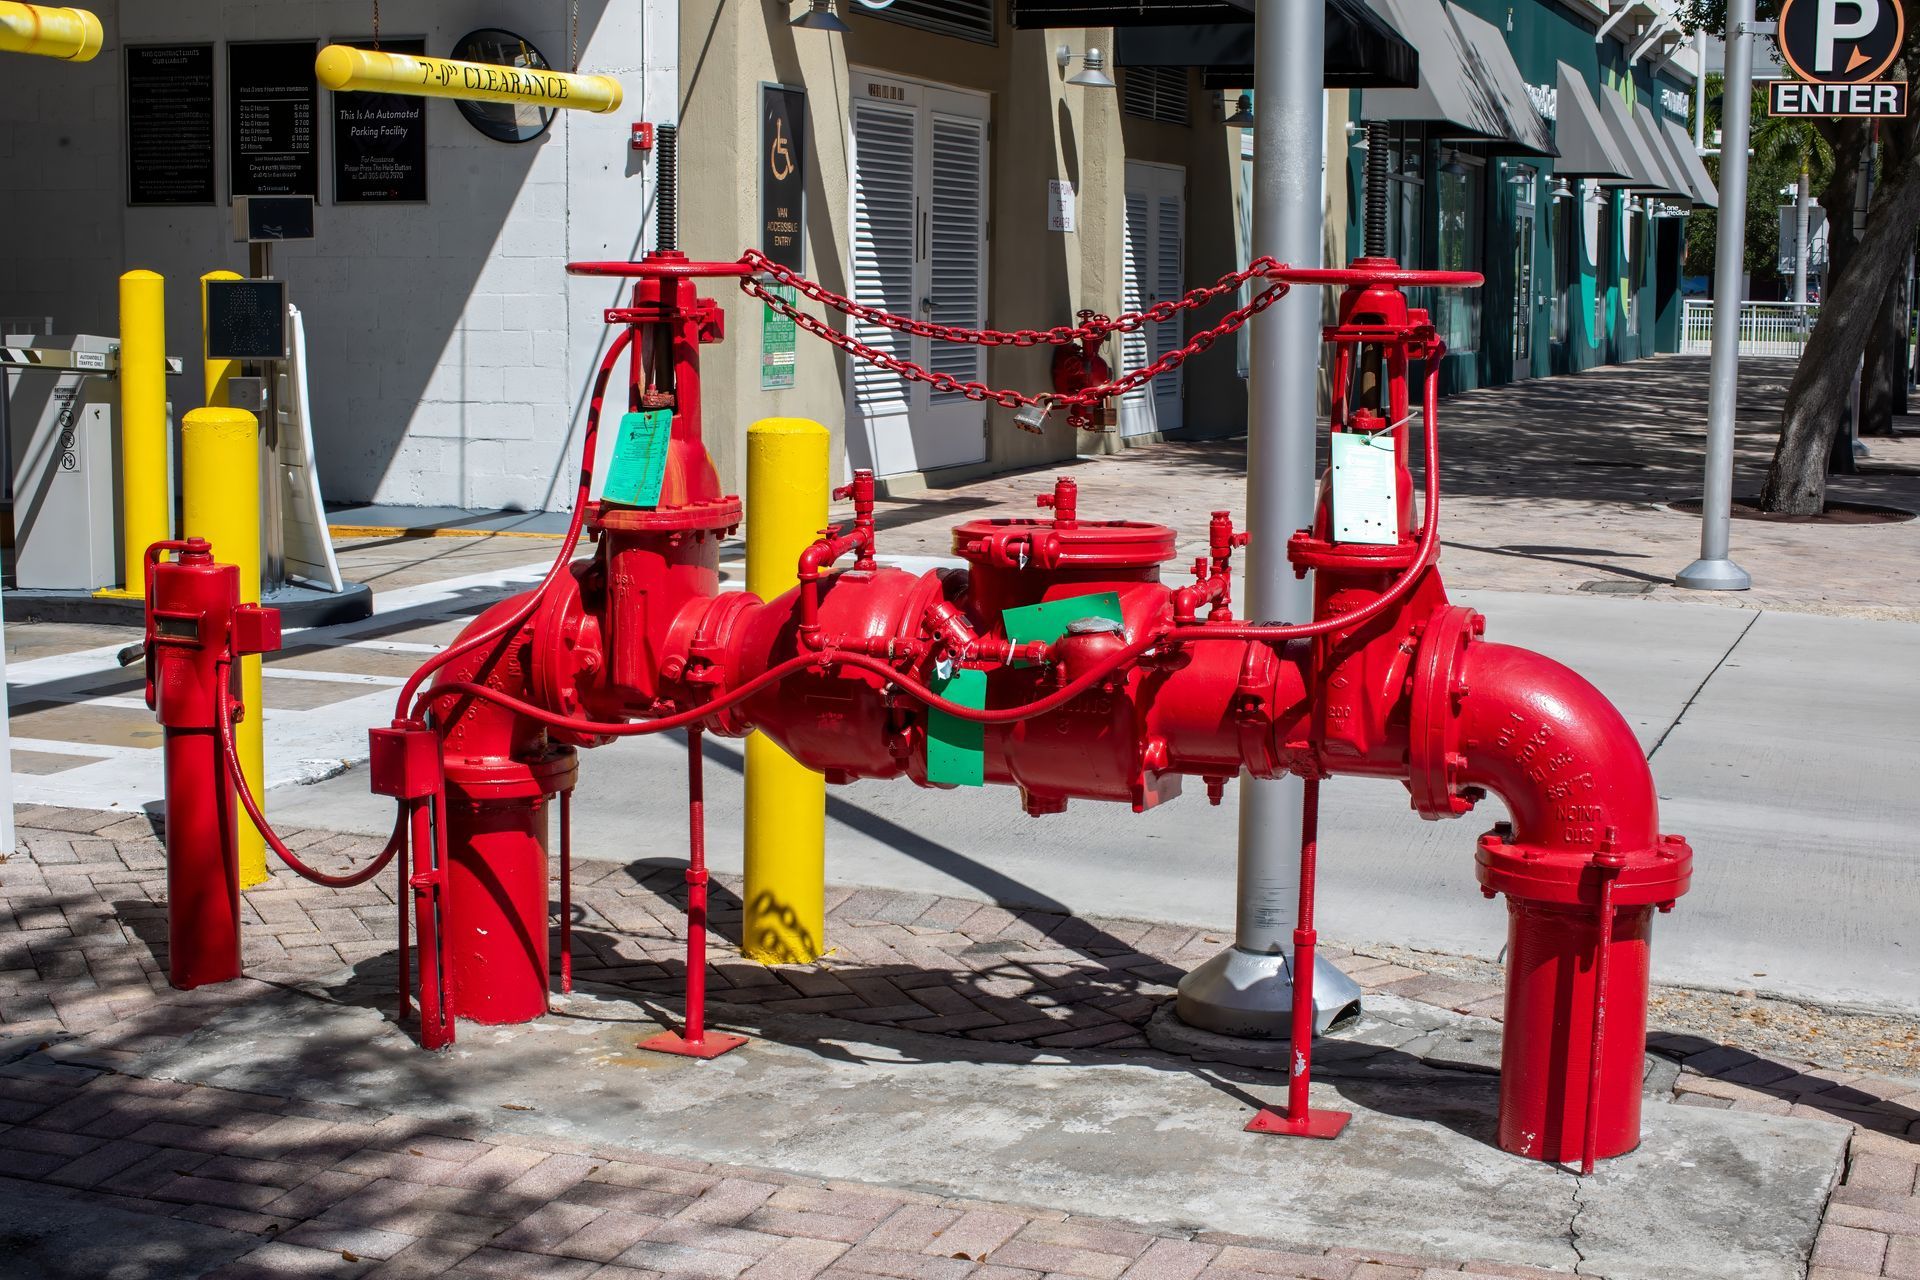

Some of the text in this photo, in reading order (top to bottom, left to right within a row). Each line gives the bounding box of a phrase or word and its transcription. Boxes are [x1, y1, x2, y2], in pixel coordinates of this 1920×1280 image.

[1815, 0, 1879, 72] P
[464, 66, 569, 98] CLEARANCE
[1777, 85, 1898, 113] ENTER
[340, 108, 419, 119] This Is An Automated
[351, 125, 408, 138] Parking Facility
[777, 207, 788, 218] VAN
[767, 221, 798, 232] ACCESSIBLE
[774, 236, 792, 246] ENTRY
